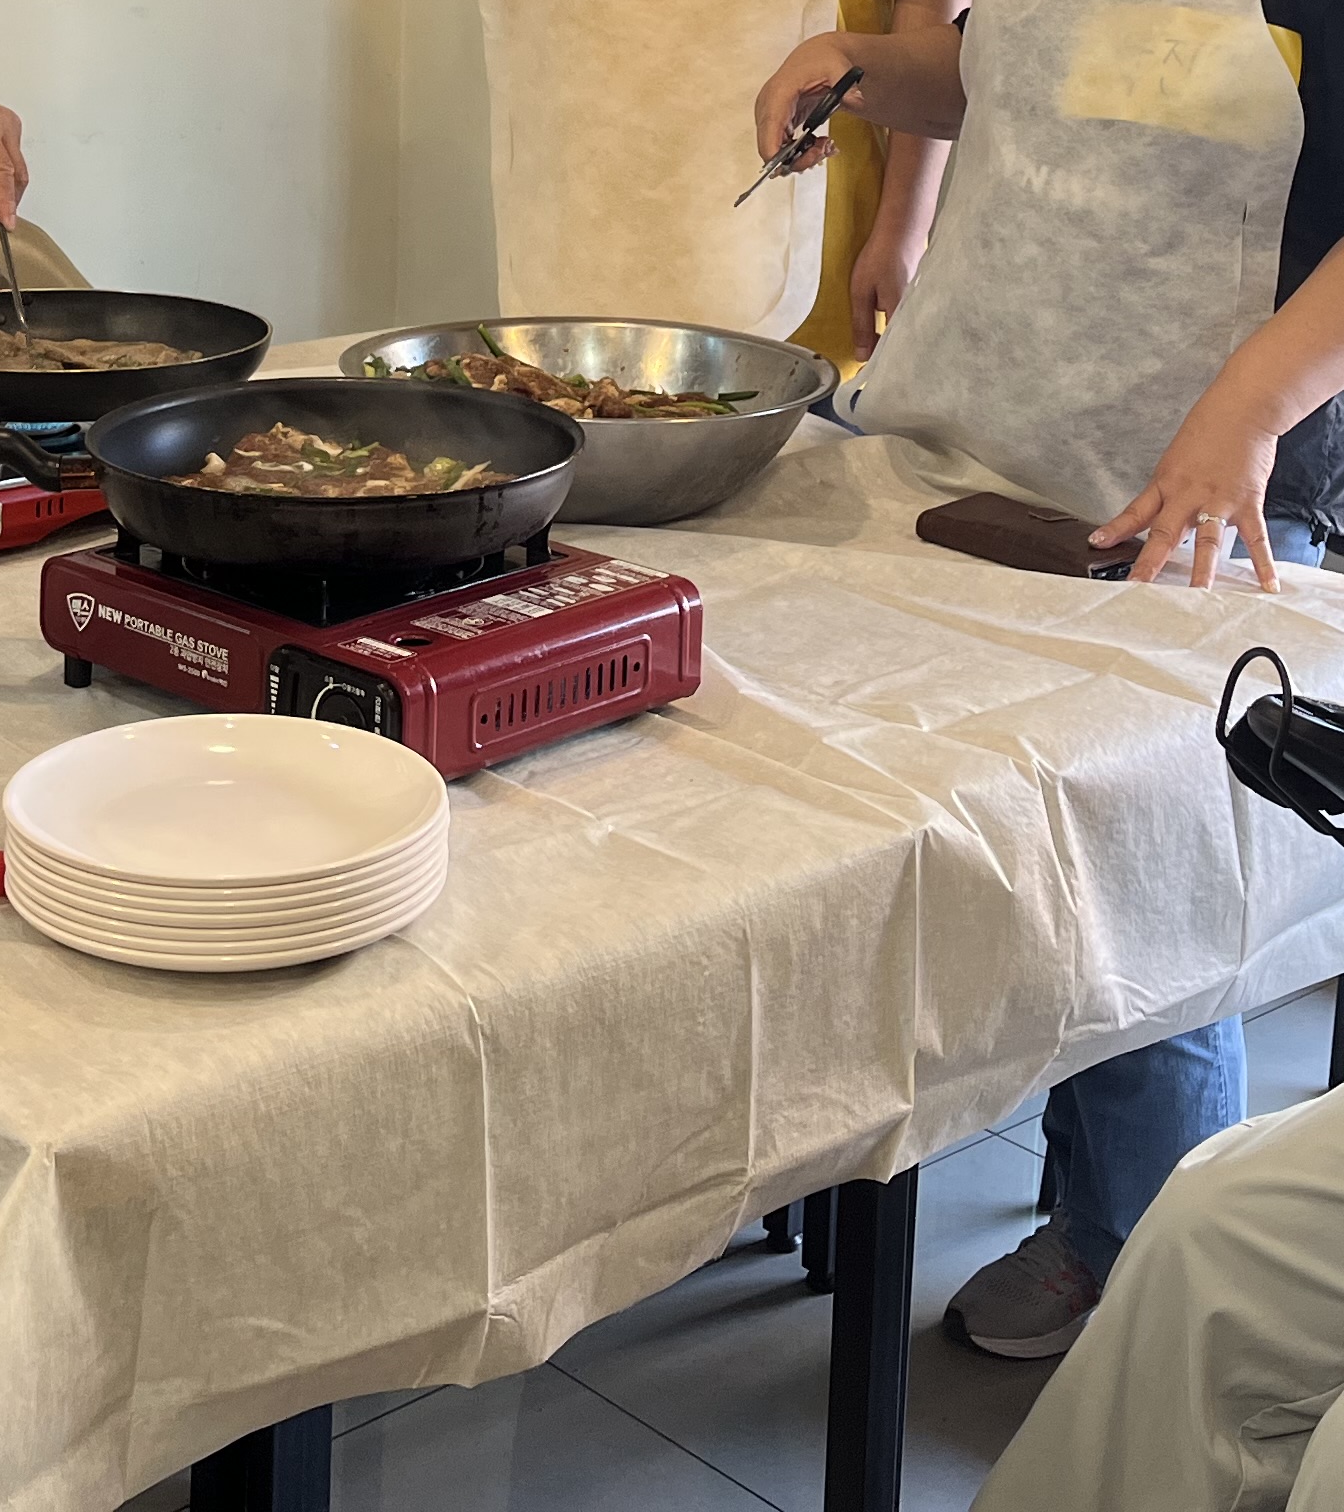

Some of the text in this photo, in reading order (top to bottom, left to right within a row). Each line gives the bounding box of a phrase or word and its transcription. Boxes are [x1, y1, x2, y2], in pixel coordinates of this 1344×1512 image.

[98, 604, 123, 625] NEW
[124, 614, 174, 643] PORTABLE
[175, 632, 196, 650] GAS
[197, 639, 229, 662] STOVE
